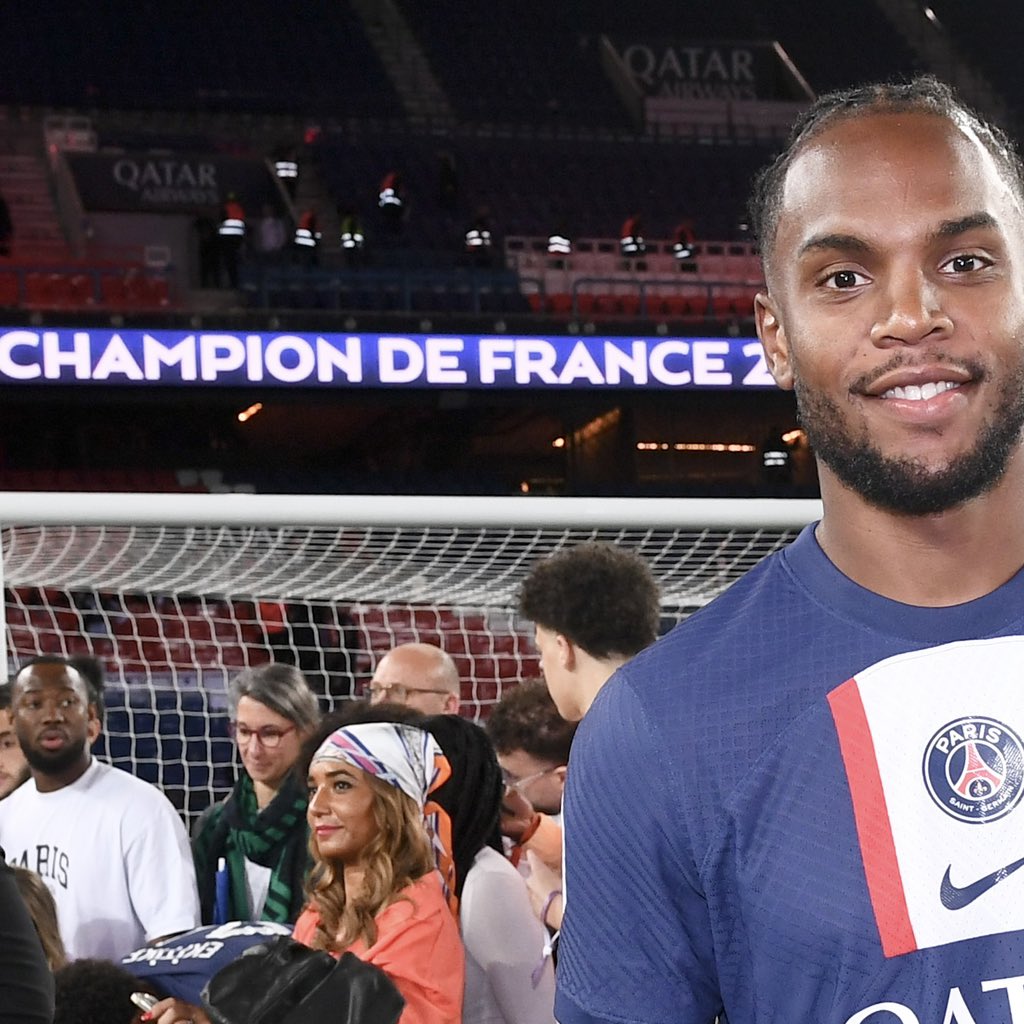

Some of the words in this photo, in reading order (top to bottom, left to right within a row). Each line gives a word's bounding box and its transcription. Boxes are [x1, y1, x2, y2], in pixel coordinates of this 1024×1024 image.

[623, 44, 755, 85] QATAR
[113, 159, 217, 191] QATAR
[0, 331, 363, 382] CHAMPION
[378, 338, 467, 383] DE
[479, 340, 733, 386] FRANCE
[935, 723, 1002, 754] PARIS
